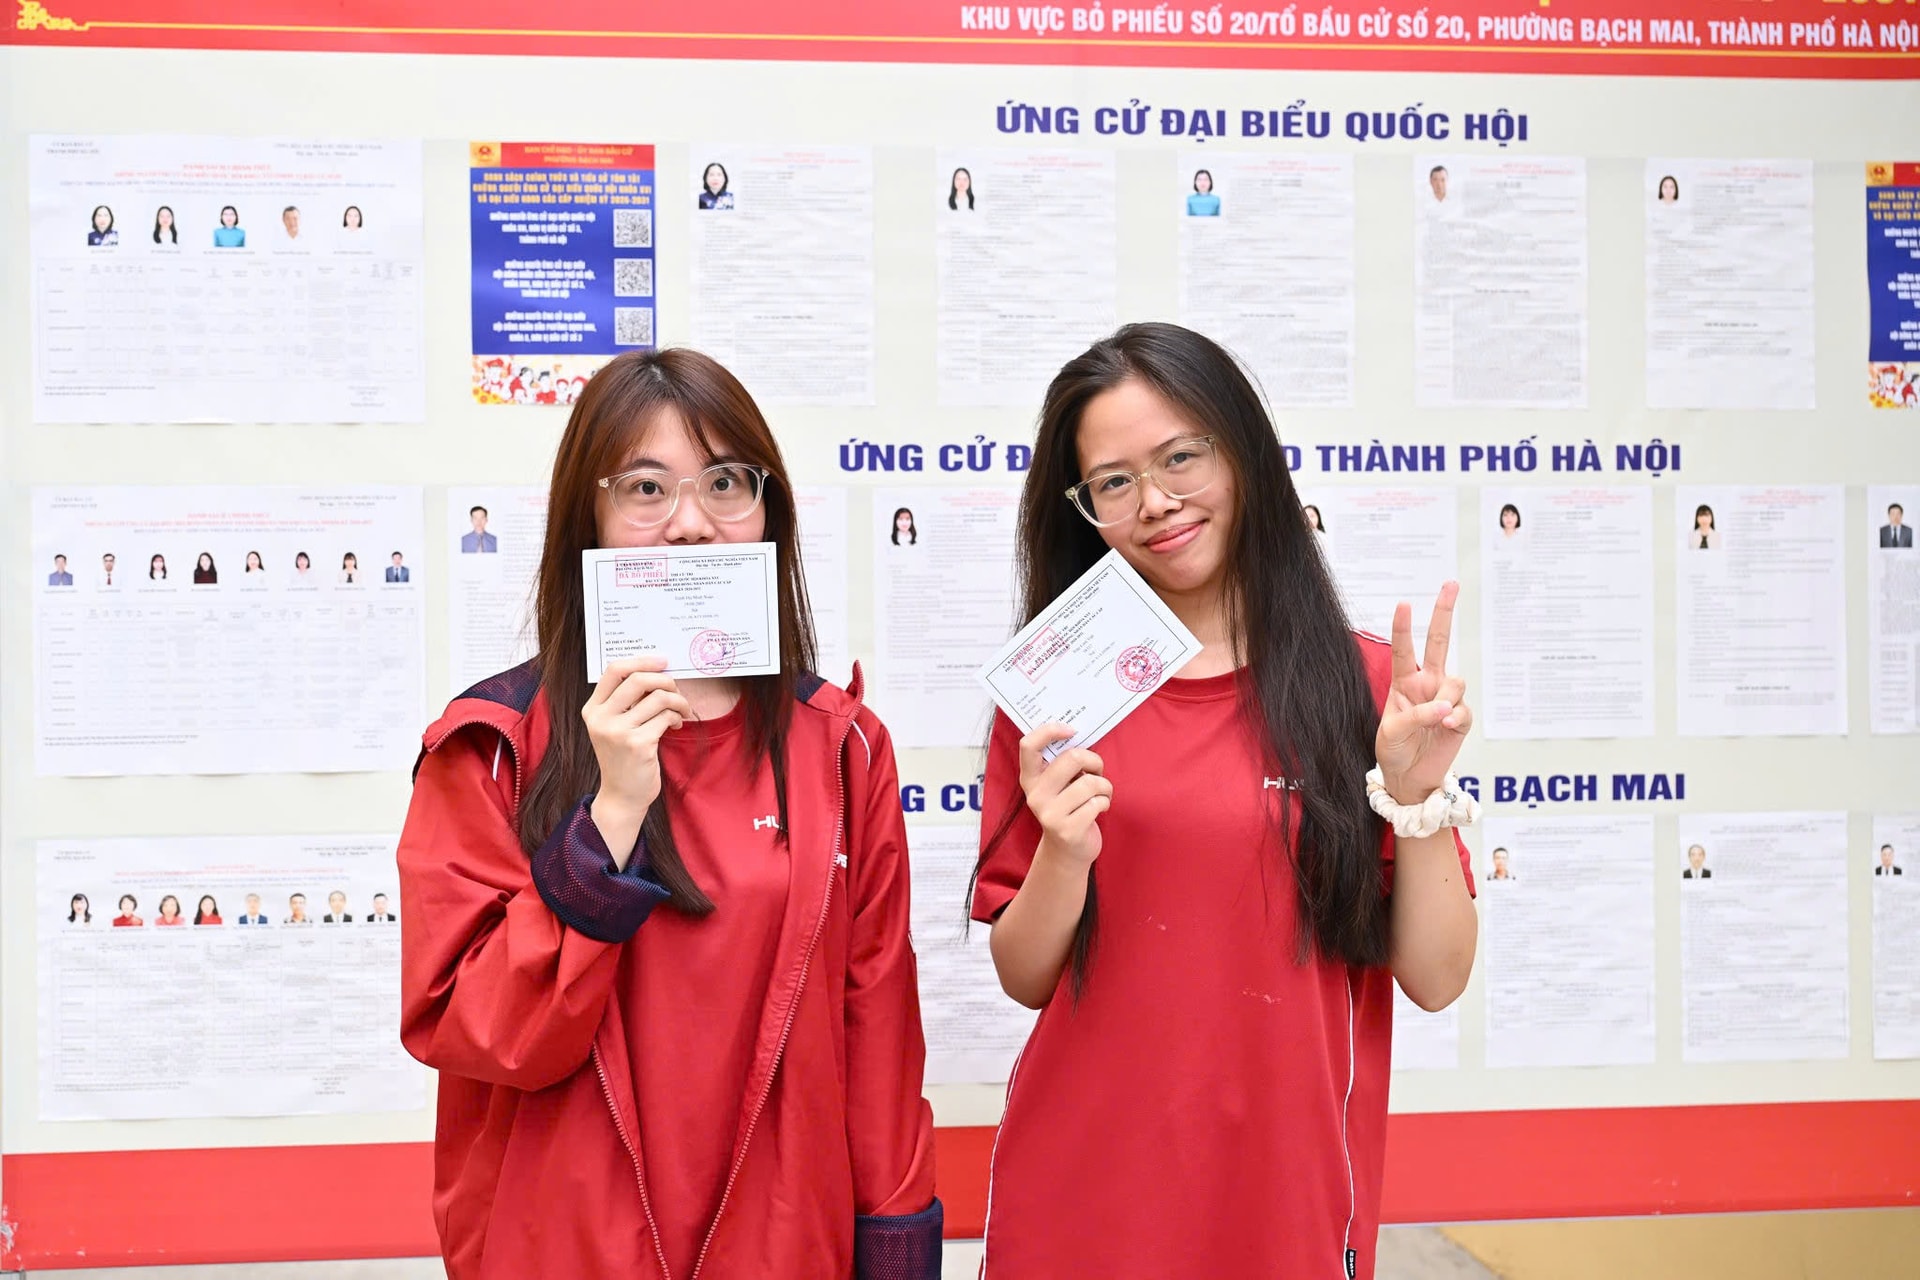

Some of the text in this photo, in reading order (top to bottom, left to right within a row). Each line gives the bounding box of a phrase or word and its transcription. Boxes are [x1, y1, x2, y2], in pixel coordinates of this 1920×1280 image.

[960, 2, 1919, 51] KHU VỰC BỎ PHIẾU SỐ 20/TỔ BẦU CỬ SỐ 20, PHƯỜNG BẠCH MAI, THÀNH PHỐ HÀ NỘI
[997, 99, 1527, 146] ỨNG CỬ ĐẠI BIỂU QUỐC HỘI
[839, 438, 923, 471] ỨNG
[939, 435, 996, 471] CỬ
[1316, 440, 1446, 472] THÀNH
[1460, 435, 1537, 472] PHỐ
[1552, 440, 1602, 472] HÀ
[1616, 439, 1681, 477] NỘI
[1494, 775, 1598, 809] BẠCH
[1612, 774, 1685, 801] MAI
